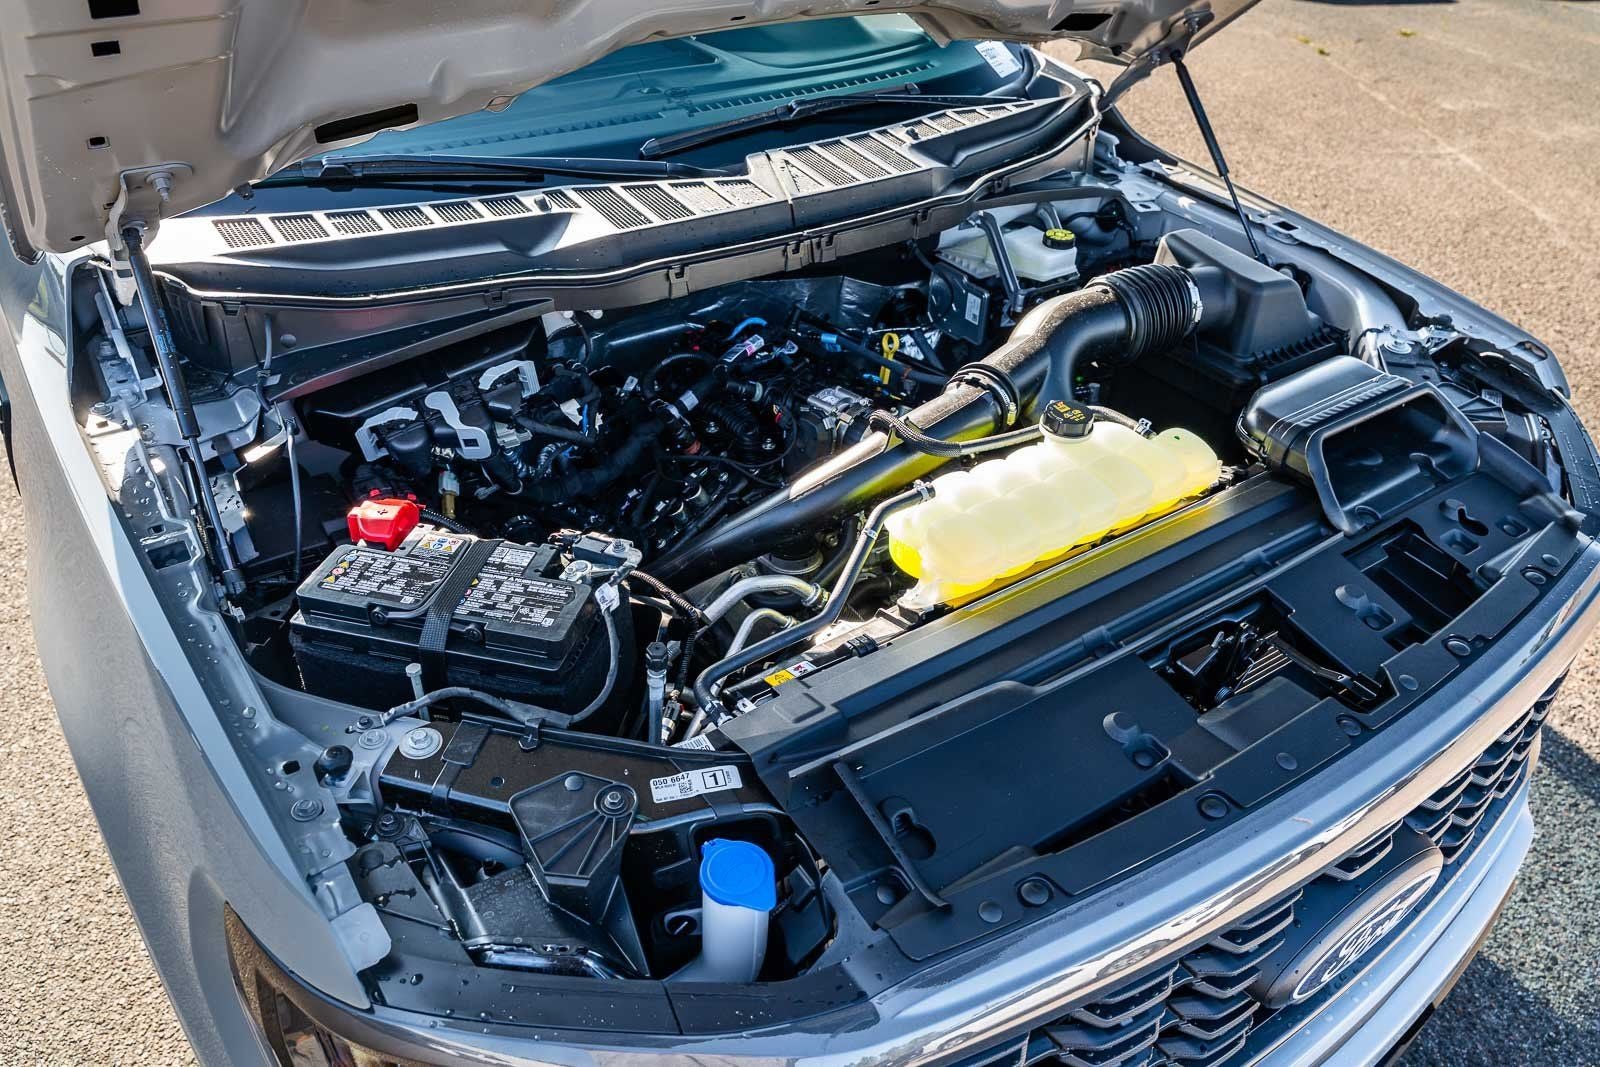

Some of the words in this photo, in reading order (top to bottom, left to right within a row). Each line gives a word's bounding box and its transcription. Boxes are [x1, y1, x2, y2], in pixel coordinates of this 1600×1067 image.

[652, 777, 668, 787] 050
[670, 772, 690, 784] 6647
[708, 772, 719, 786] 1
